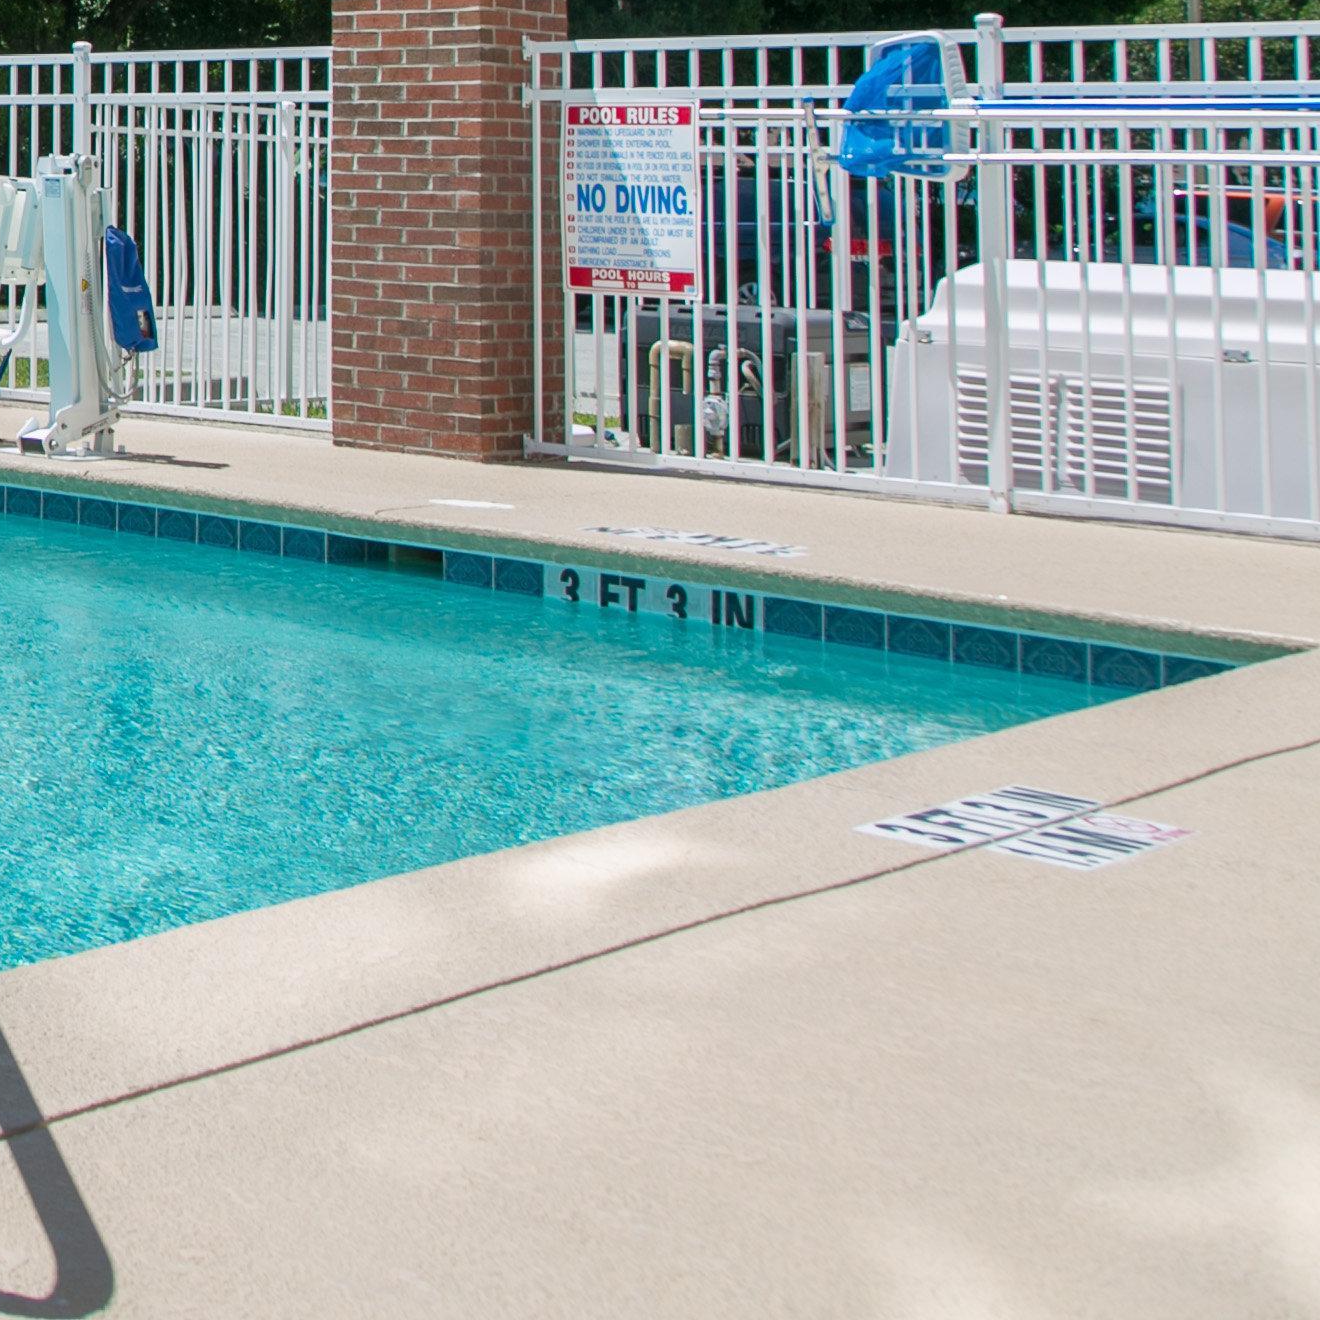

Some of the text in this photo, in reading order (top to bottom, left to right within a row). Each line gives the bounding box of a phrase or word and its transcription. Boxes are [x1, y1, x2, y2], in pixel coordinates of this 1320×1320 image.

[579, 107, 679, 124] POOL RULES
[577, 140, 653, 148] SHOWER BEFORE ENTERING
[586, 173, 598, 182] NOT
[600, 173, 627, 182] SWALLOW
[577, 183, 606, 213] NO
[577, 226, 605, 234] CHILDREN
[608, 226, 627, 235] UNDER
[652, 228, 664, 236] OLD
[667, 228, 684, 237] MUST
[578, 235, 618, 244] ACCOMPANIED
[620, 236, 627, 245] BY
[630, 237, 638, 245] AN
[578, 246, 600, 255] BATHING
[578, 258, 648, 268] EMERGENCY ASSISTANCE
[592, 269, 670, 282] POOL HOURS
[560, 568, 755, 630] 3 FT 3 IN
[873, 786, 1098, 845] 3 FT 3 IN
